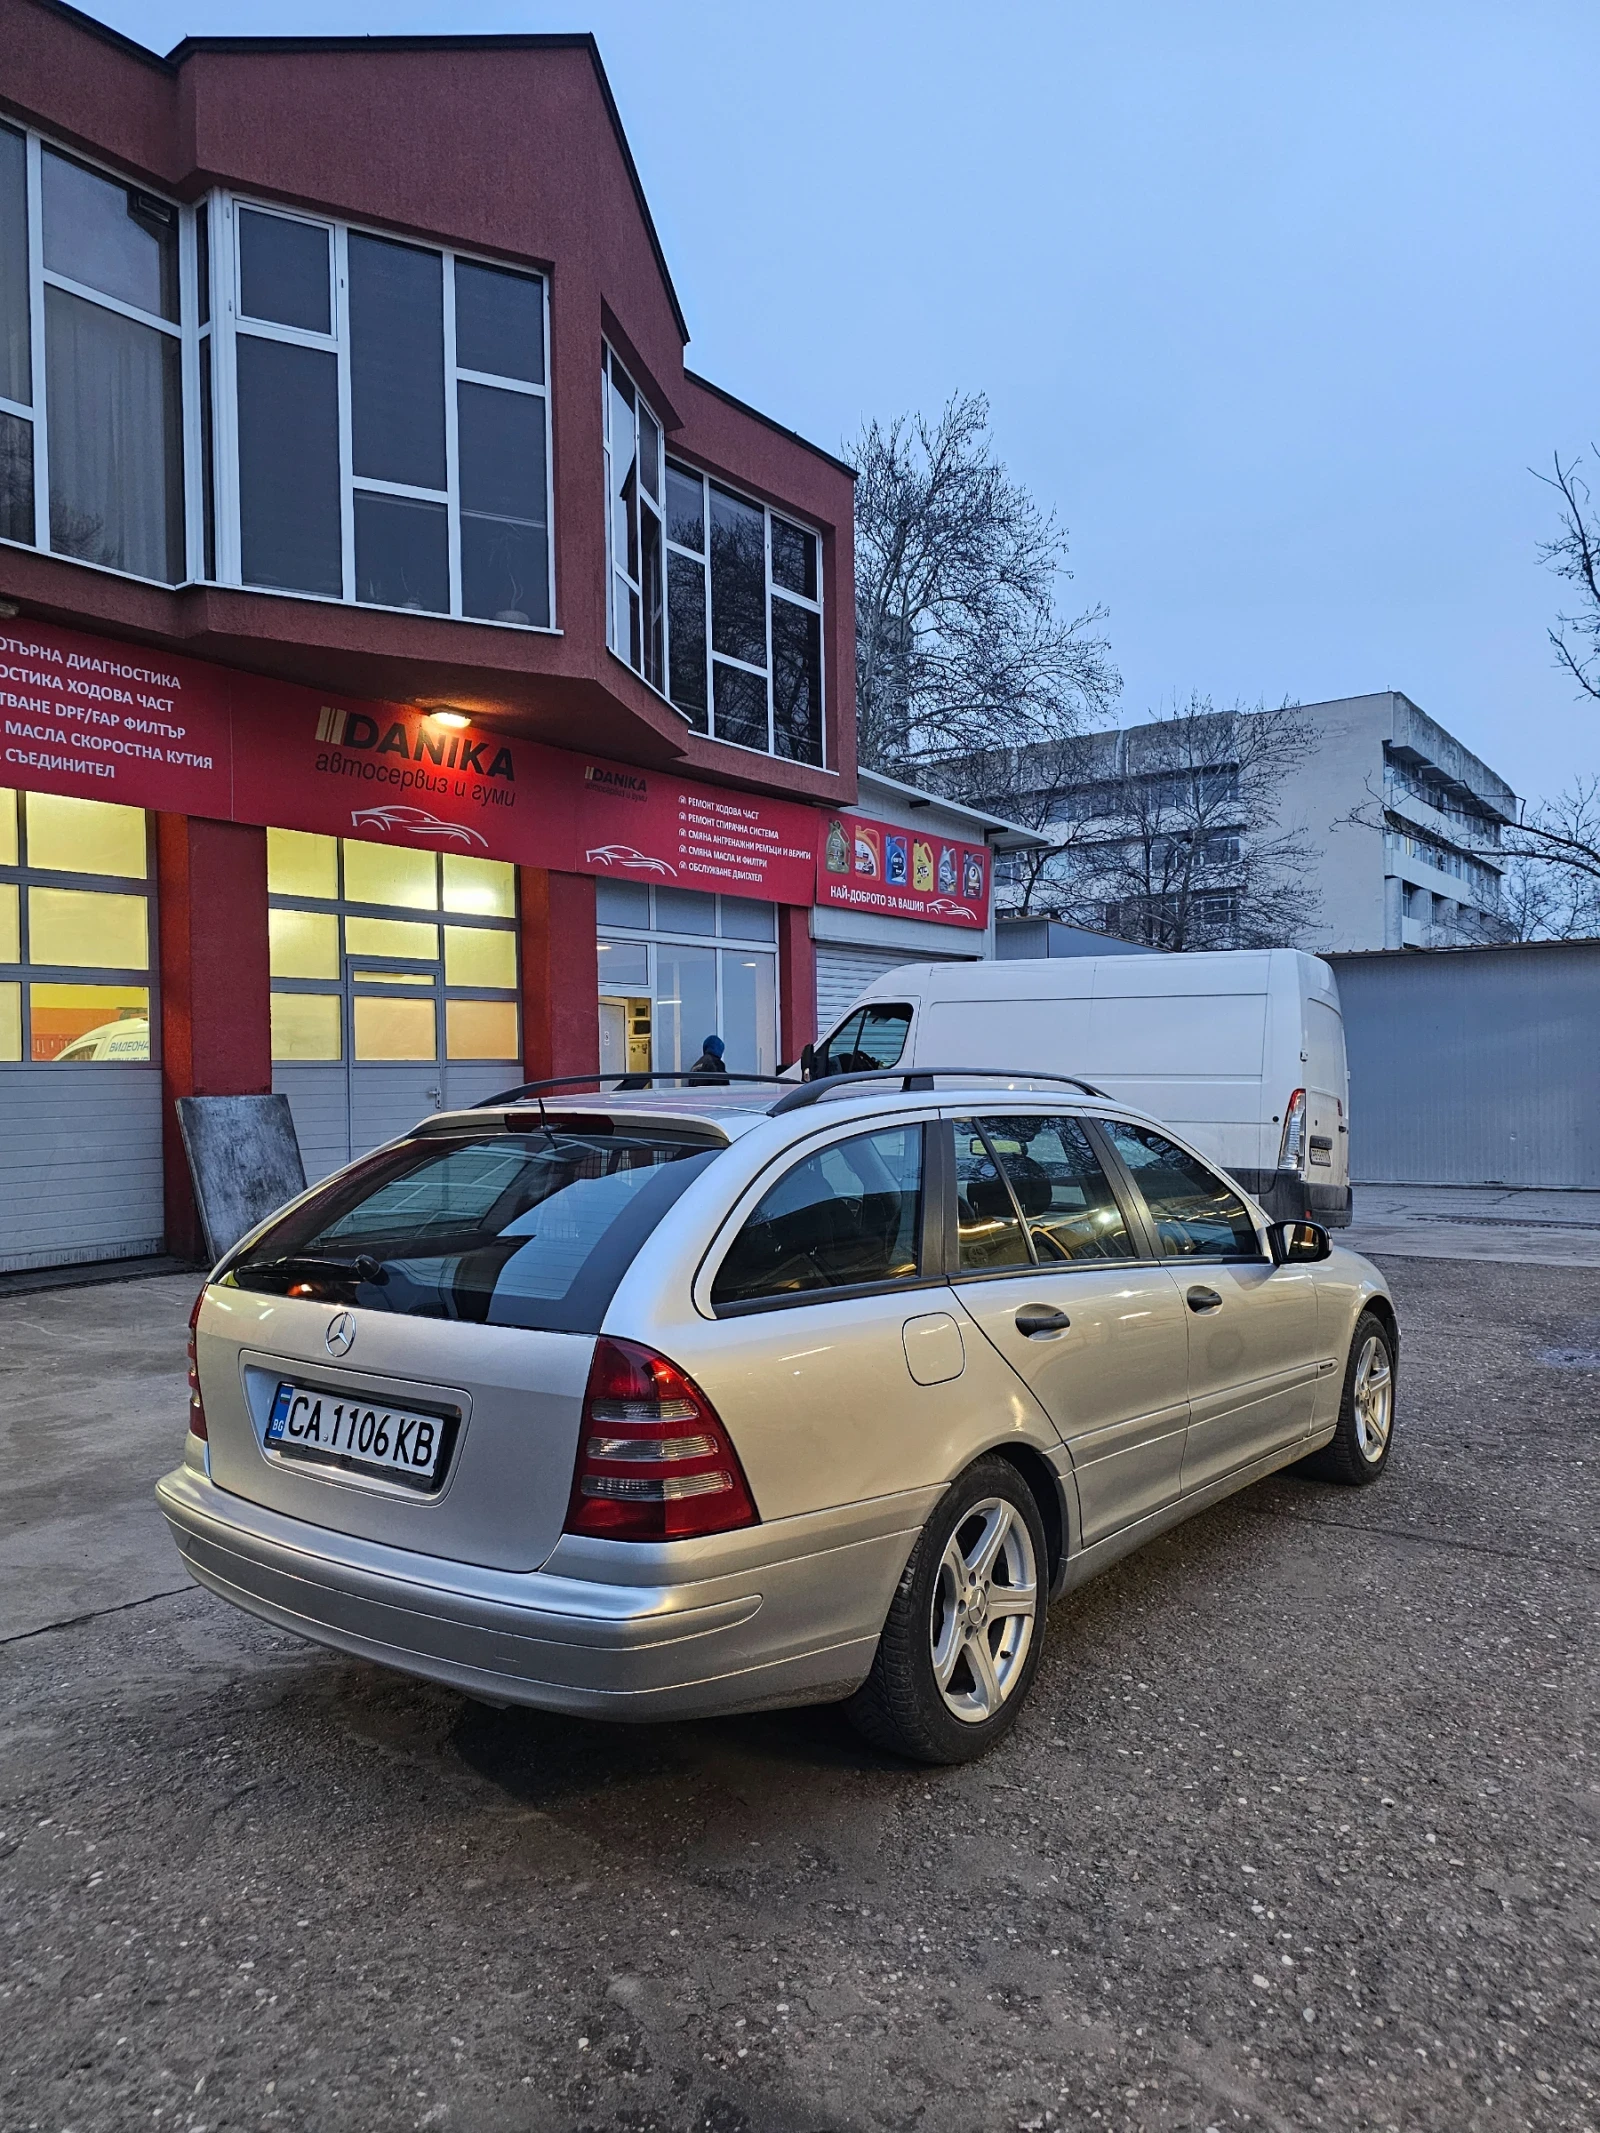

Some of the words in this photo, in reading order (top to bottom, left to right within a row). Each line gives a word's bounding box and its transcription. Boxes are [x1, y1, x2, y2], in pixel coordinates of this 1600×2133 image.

[67, 653, 181, 689] ДИАГНОСТИКА
[67, 679, 133, 705] ХОДОВА
[137, 693, 174, 712] ЧАСТ
[55, 703, 120, 727] DPF/FAP
[123, 716, 186, 740] ФИЛТЪР
[5, 720, 67, 744] МАСЛА
[70, 732, 163, 761] СКОРОСТНА
[166, 749, 213, 769] КУТИЯ
[343, 713, 515, 781] DANIKA
[5, 748, 115, 778] СЪЕДИНИТЕЛ
[315, 752, 448, 794] автосервиз
[454, 782, 466, 797] и
[471, 784, 516, 807] гуми
[593, 768, 647, 792] DANIKA
[688, 797, 715, 811] РЕМОНТ
[715, 803, 742, 817] ХОДОВА
[742, 810, 759, 820] ЧАСТ
[688, 814, 715, 827] РЕМОНТ
[716, 819, 749, 834] СПИРАЧНА
[749, 826, 779, 840] СИСТЕМА
[688, 830, 712, 843] СМЯНА
[713, 835, 755, 850] АНГРЕНАЖНИ
[755, 842, 782, 857] РЕМЪЦИ
[783, 848, 788, 857] И
[788, 849, 811, 860] ВЕРИГИ
[688, 846, 712, 859] СМЯНА
[713, 850, 735, 863] МАСЛА
[736, 855, 741, 864] И
[741, 856, 768, 868] ФИЛТРИ
[688, 862, 732, 878] ОБСЛУЖВАНЕ
[732, 869, 763, 883] ДВИГАТЕЛ
[830, 885, 886, 906] НАЙ-ДОБРОТО
[887, 895, 897, 908] ЗА
[898, 898, 924, 912] ВАШИЯ
[272, 1418, 285, 1432] BG
[331, 1403, 391, 1456] 1106
